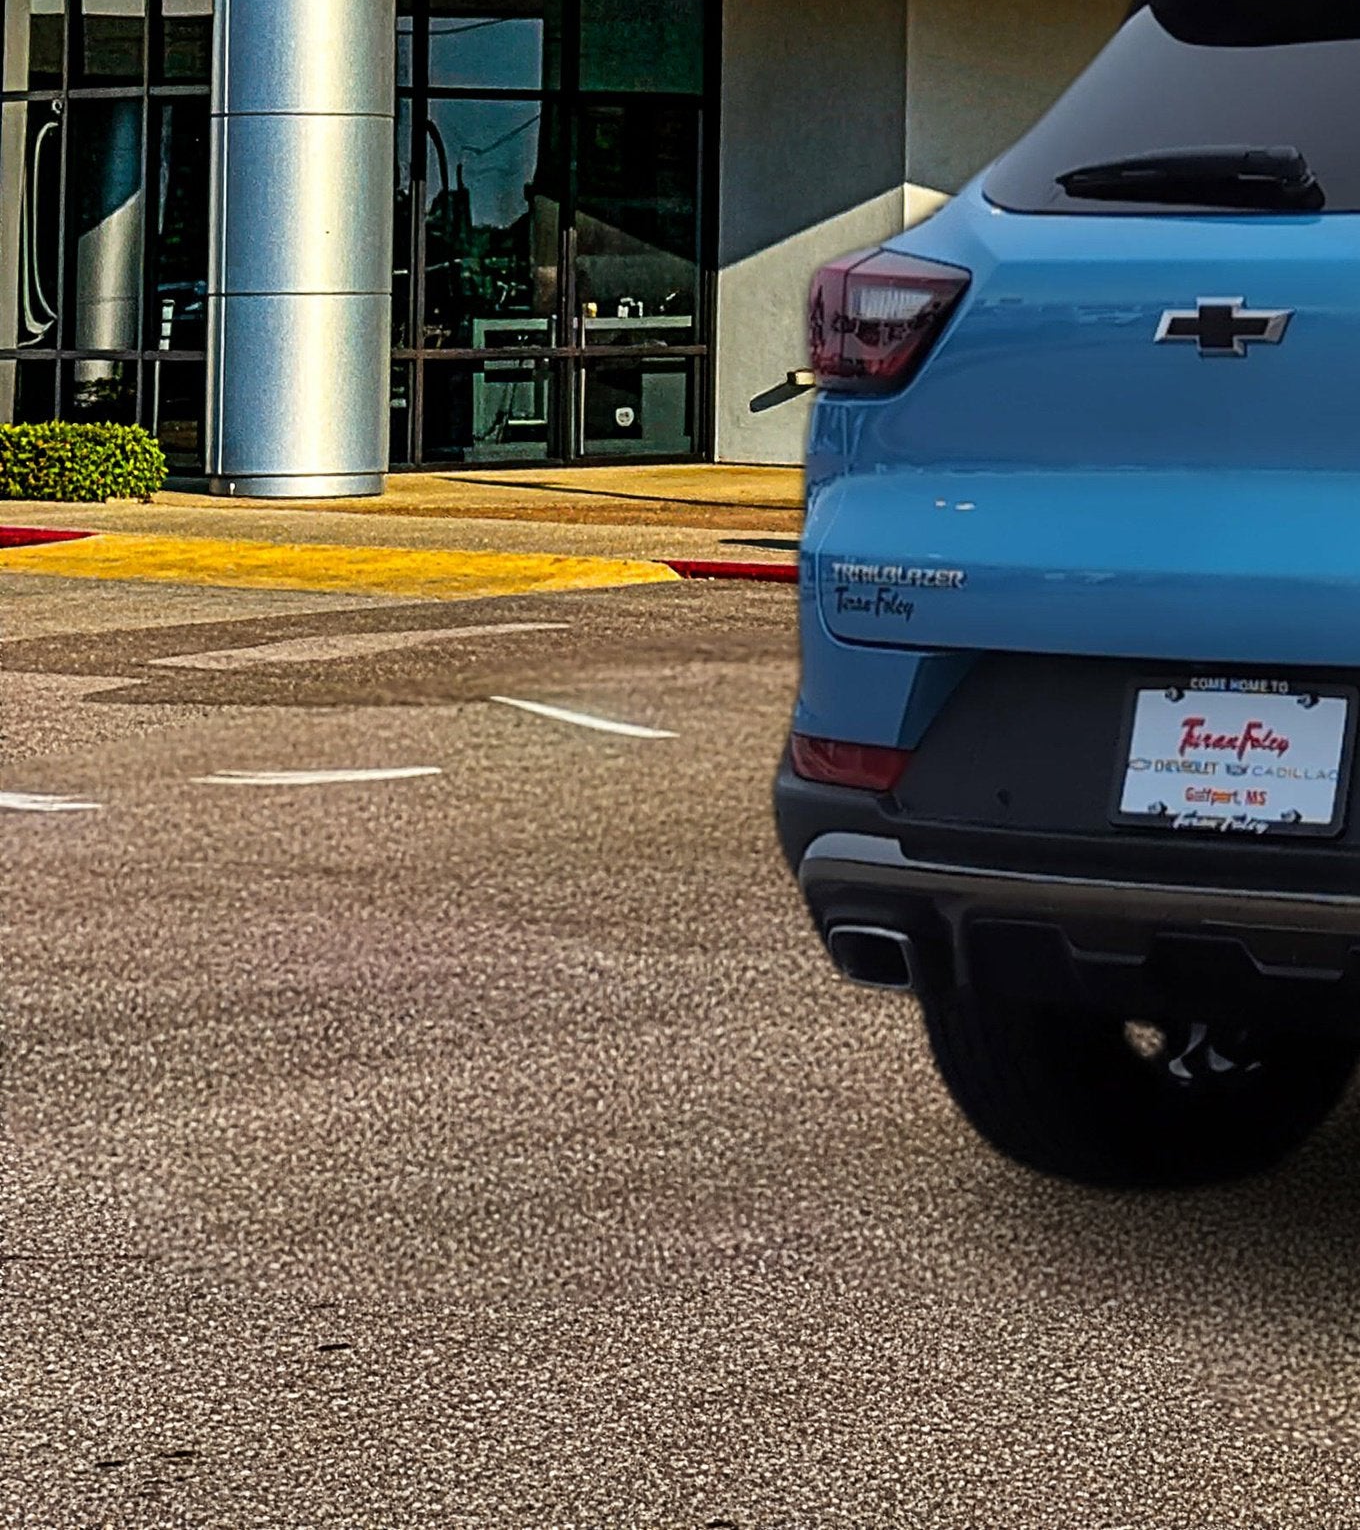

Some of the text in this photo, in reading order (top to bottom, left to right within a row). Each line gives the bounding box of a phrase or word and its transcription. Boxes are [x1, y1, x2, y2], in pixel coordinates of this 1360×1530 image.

[832, 562, 967, 588] TRAILBLAZER
[1190, 676, 1227, 690] COME
[1270, 680, 1290, 694] TO
[1251, 764, 1339, 781] CADILLAC
[1245, 788, 1268, 806] MS
